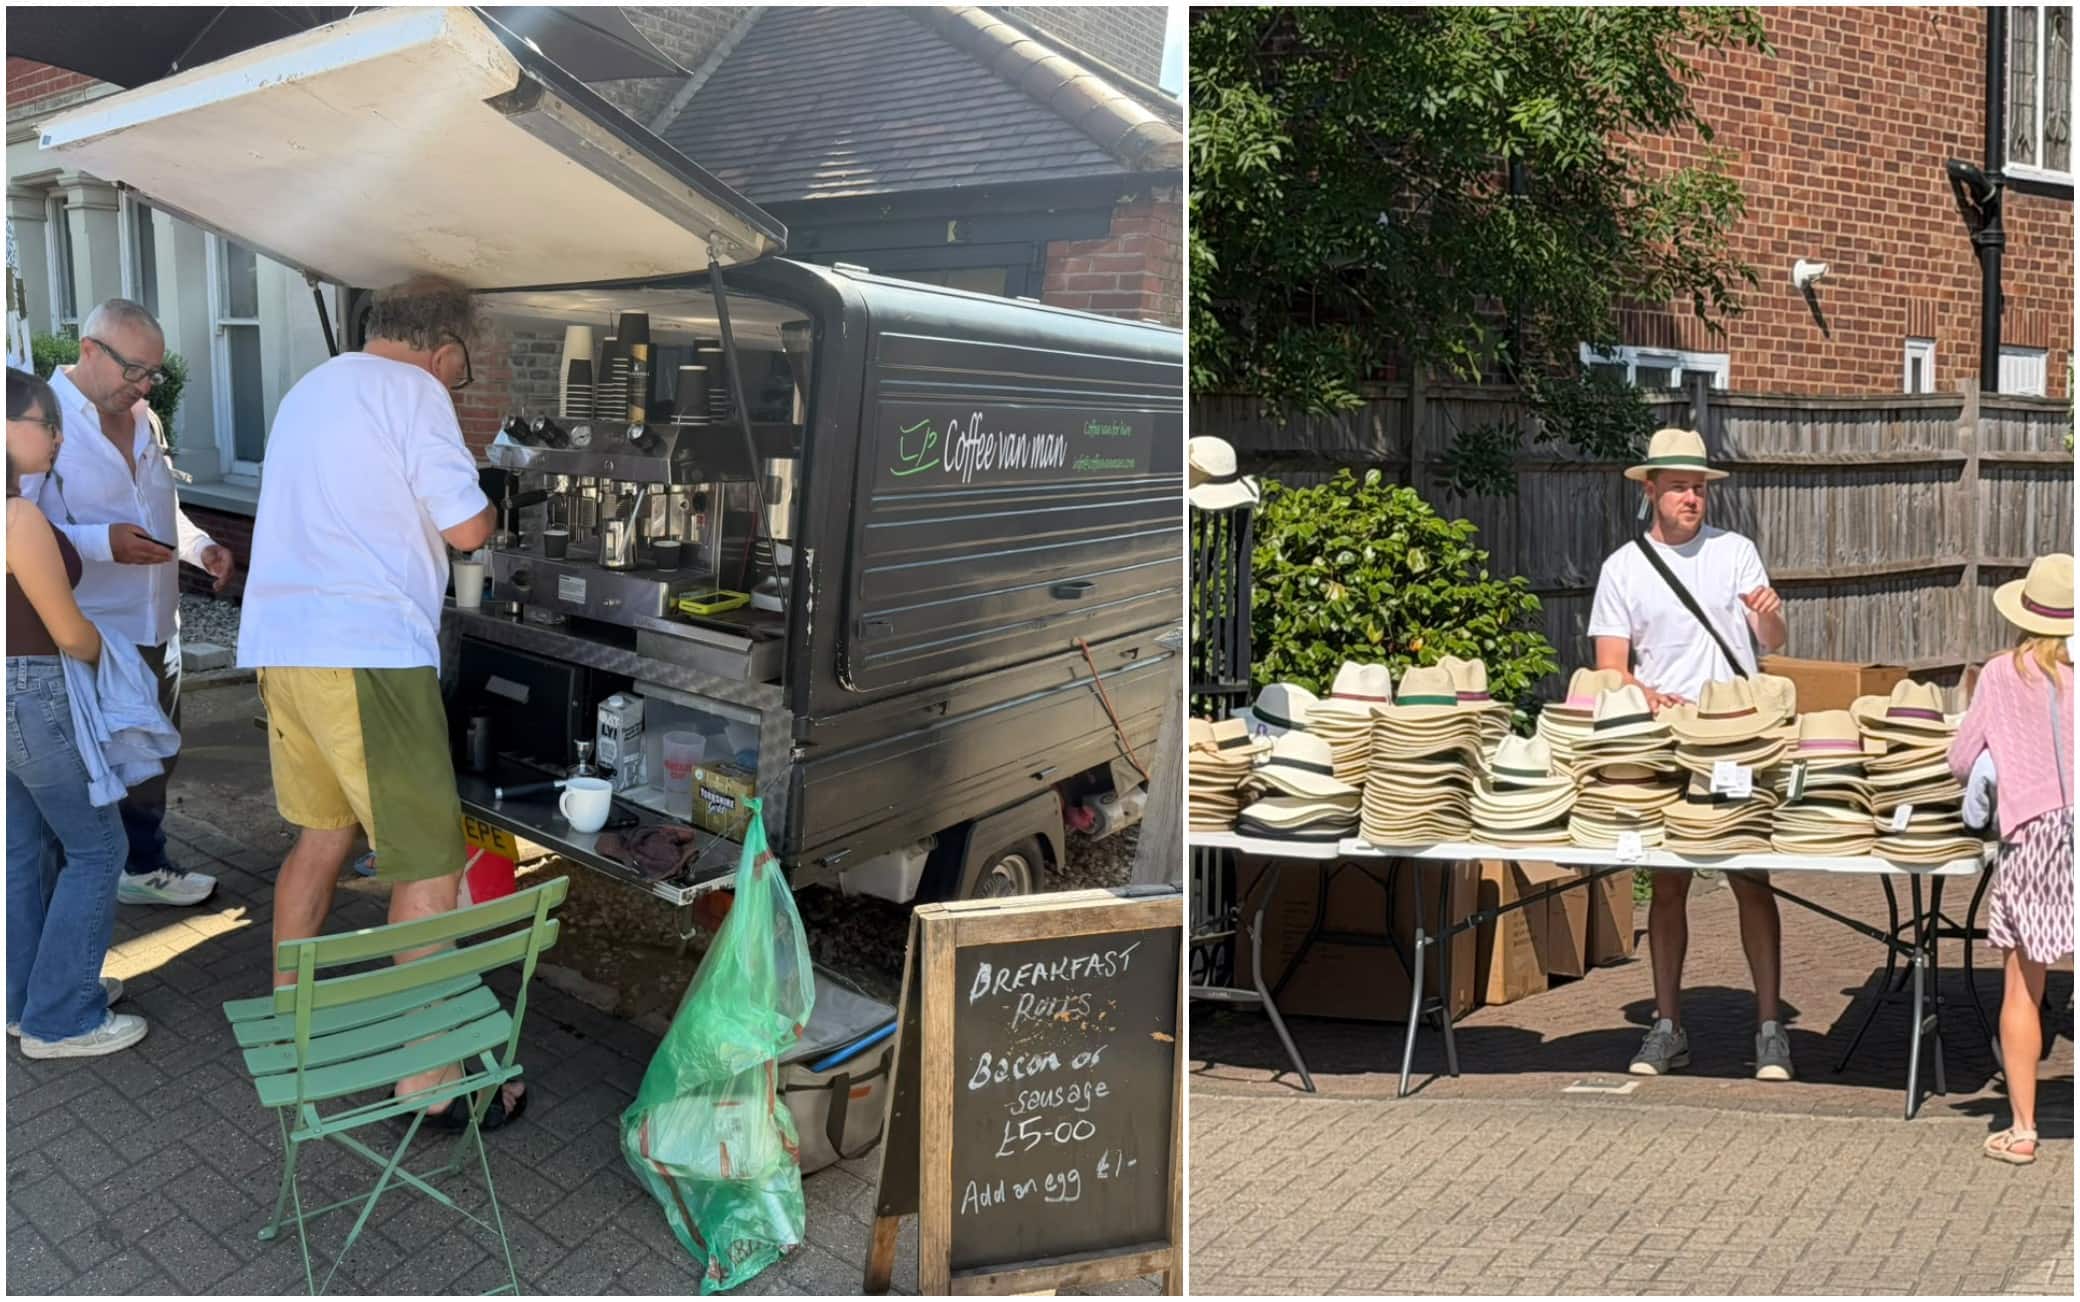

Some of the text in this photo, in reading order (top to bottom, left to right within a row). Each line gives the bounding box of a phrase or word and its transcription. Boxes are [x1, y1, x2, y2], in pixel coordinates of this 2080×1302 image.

[944, 411, 998, 484] Coffee
[998, 431, 1031, 470] van
[1030, 433, 1068, 470] man
[464, 816, 506, 849] EPE
[969, 941, 1141, 1005] BREAKFAST
[968, 1044, 1108, 1090] Bacon or
[1010, 1081, 1110, 1116] sausage
[961, 1179, 1006, 1216] Add
[1012, 1178, 1037, 1199] an
[1044, 1168, 1081, 1202] egg
